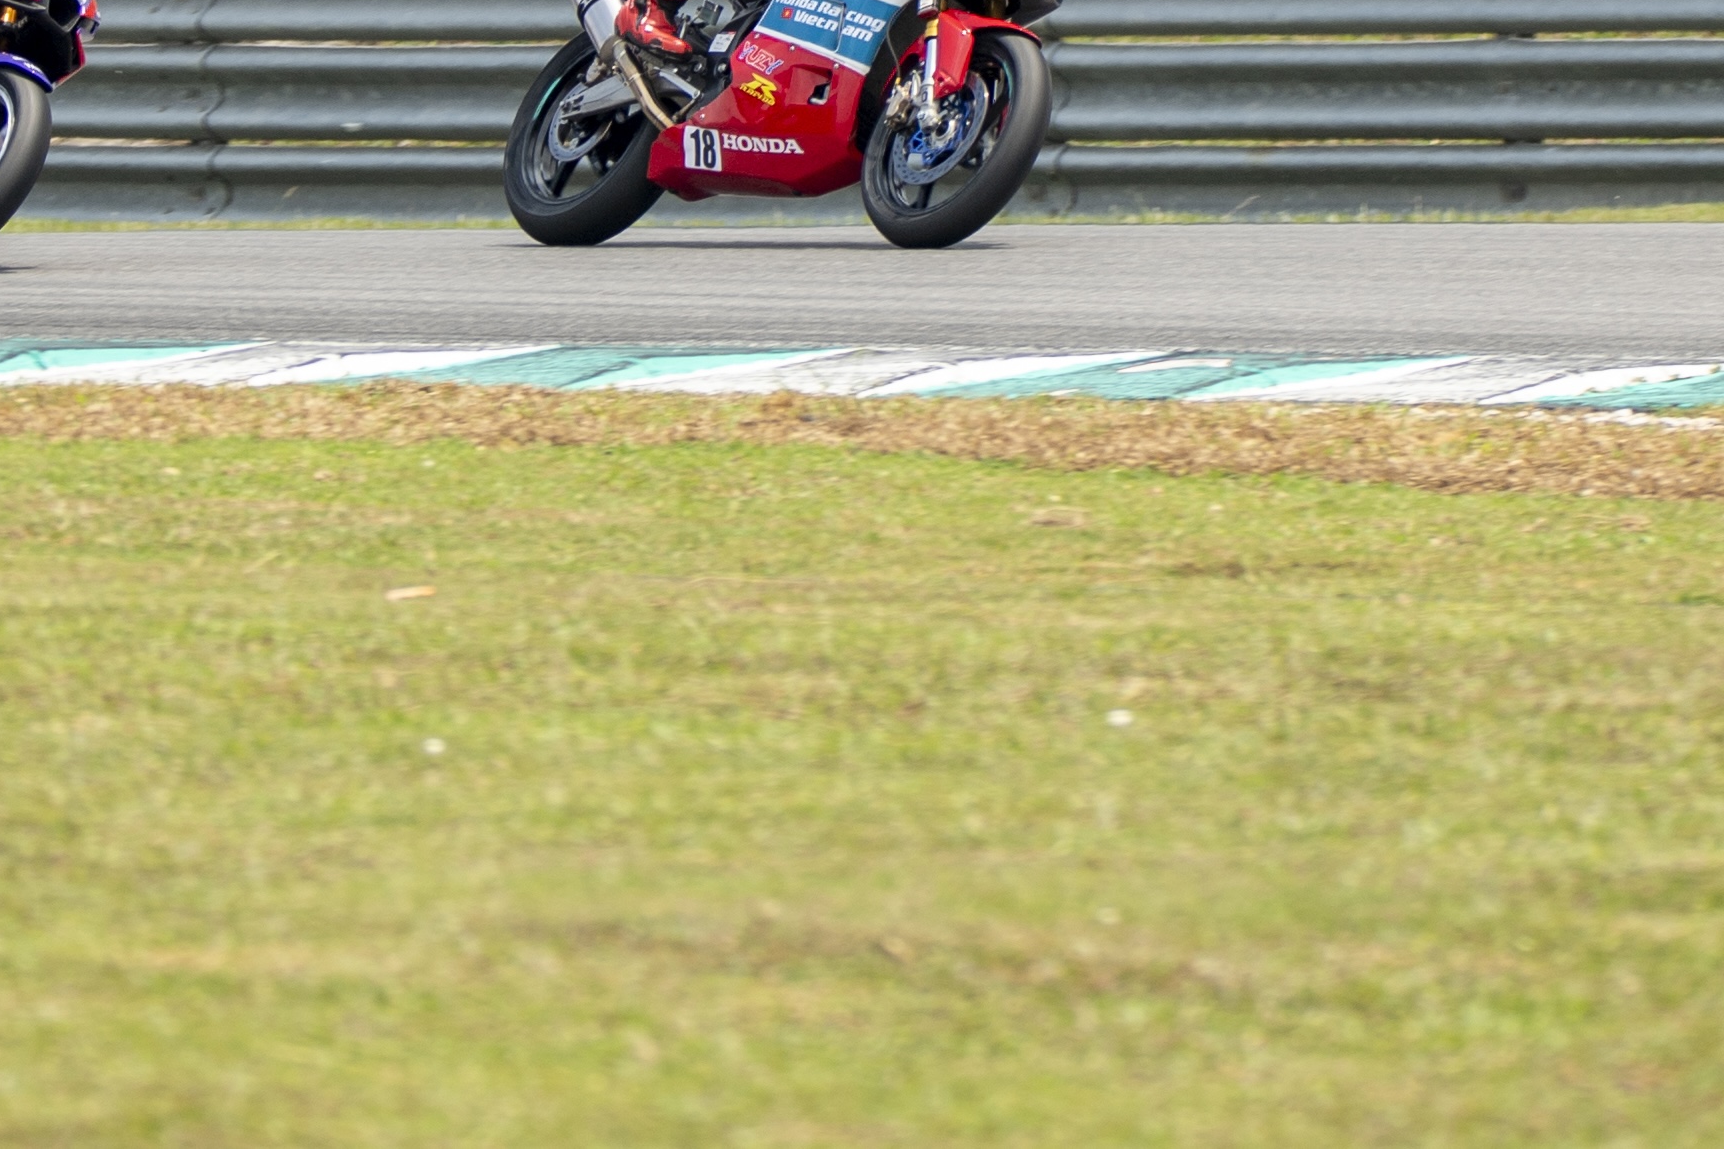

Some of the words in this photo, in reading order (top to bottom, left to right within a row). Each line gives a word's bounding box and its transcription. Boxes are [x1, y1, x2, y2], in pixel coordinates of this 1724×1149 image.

[794, 9, 874, 43] Vietnam
[689, 128, 717, 169] 18
[721, 132, 805, 155] HONDA
